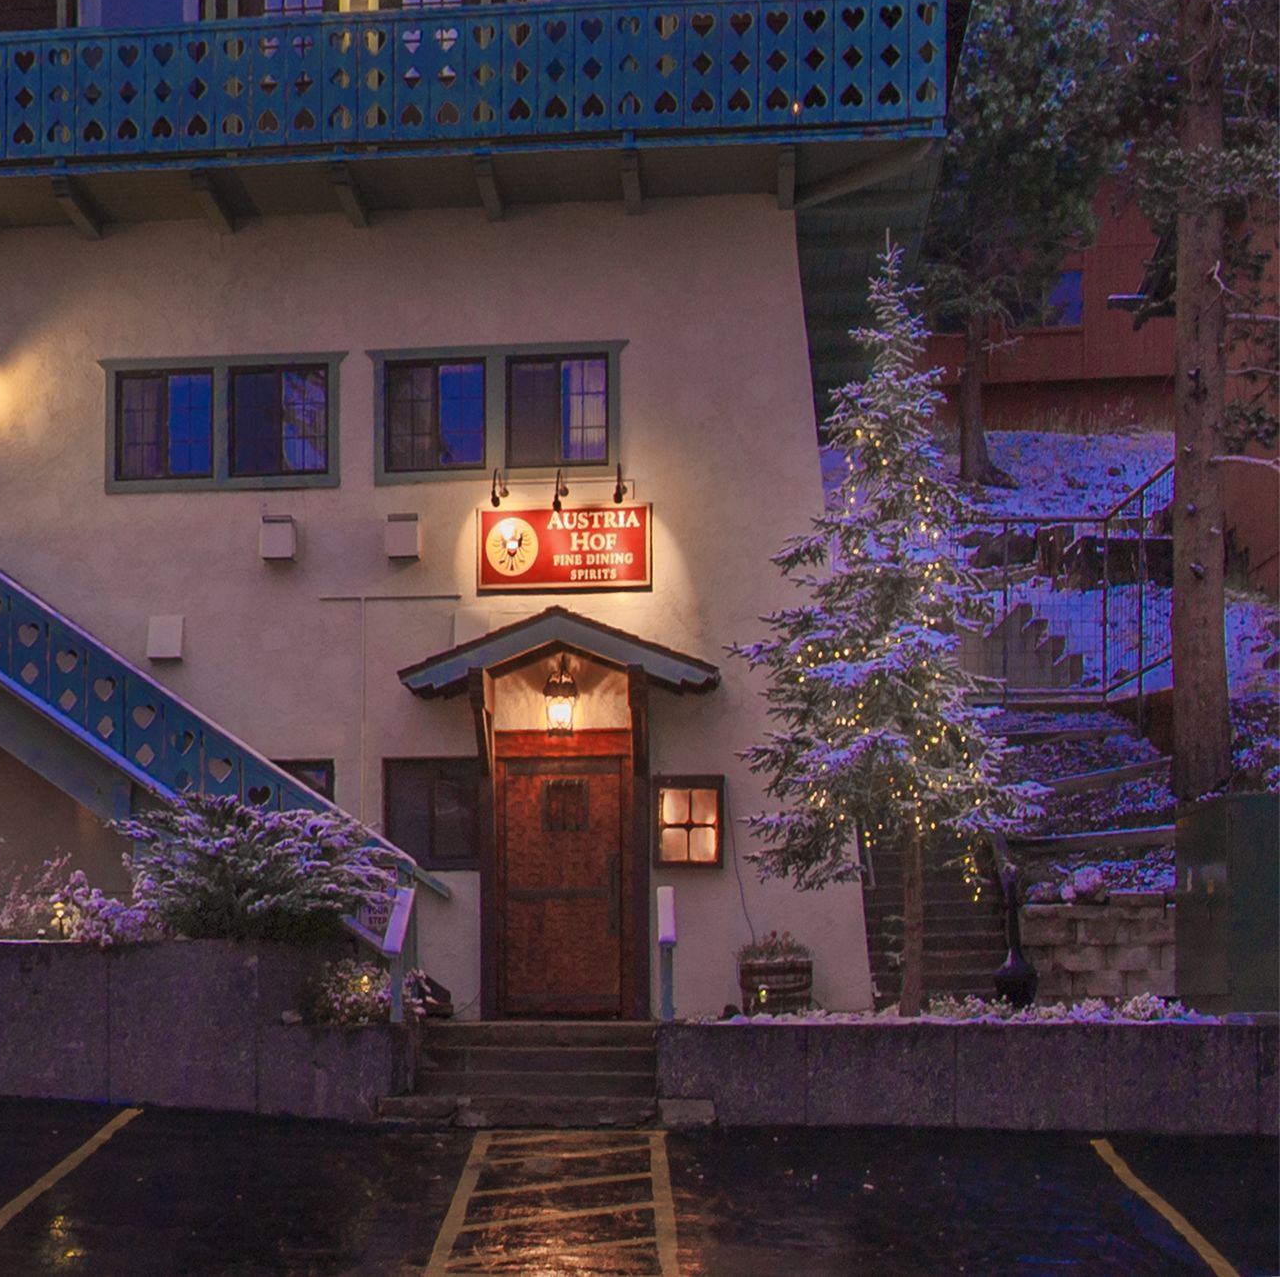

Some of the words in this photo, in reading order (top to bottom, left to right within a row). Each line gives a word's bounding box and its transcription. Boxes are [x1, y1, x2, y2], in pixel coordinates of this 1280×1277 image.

[546, 509, 641, 531] AUSTRIA
[569, 531, 618, 552] HOF
[552, 553, 583, 567] FINE
[585, 552, 634, 565] DINING
[569, 568, 618, 581] SPIRITS
